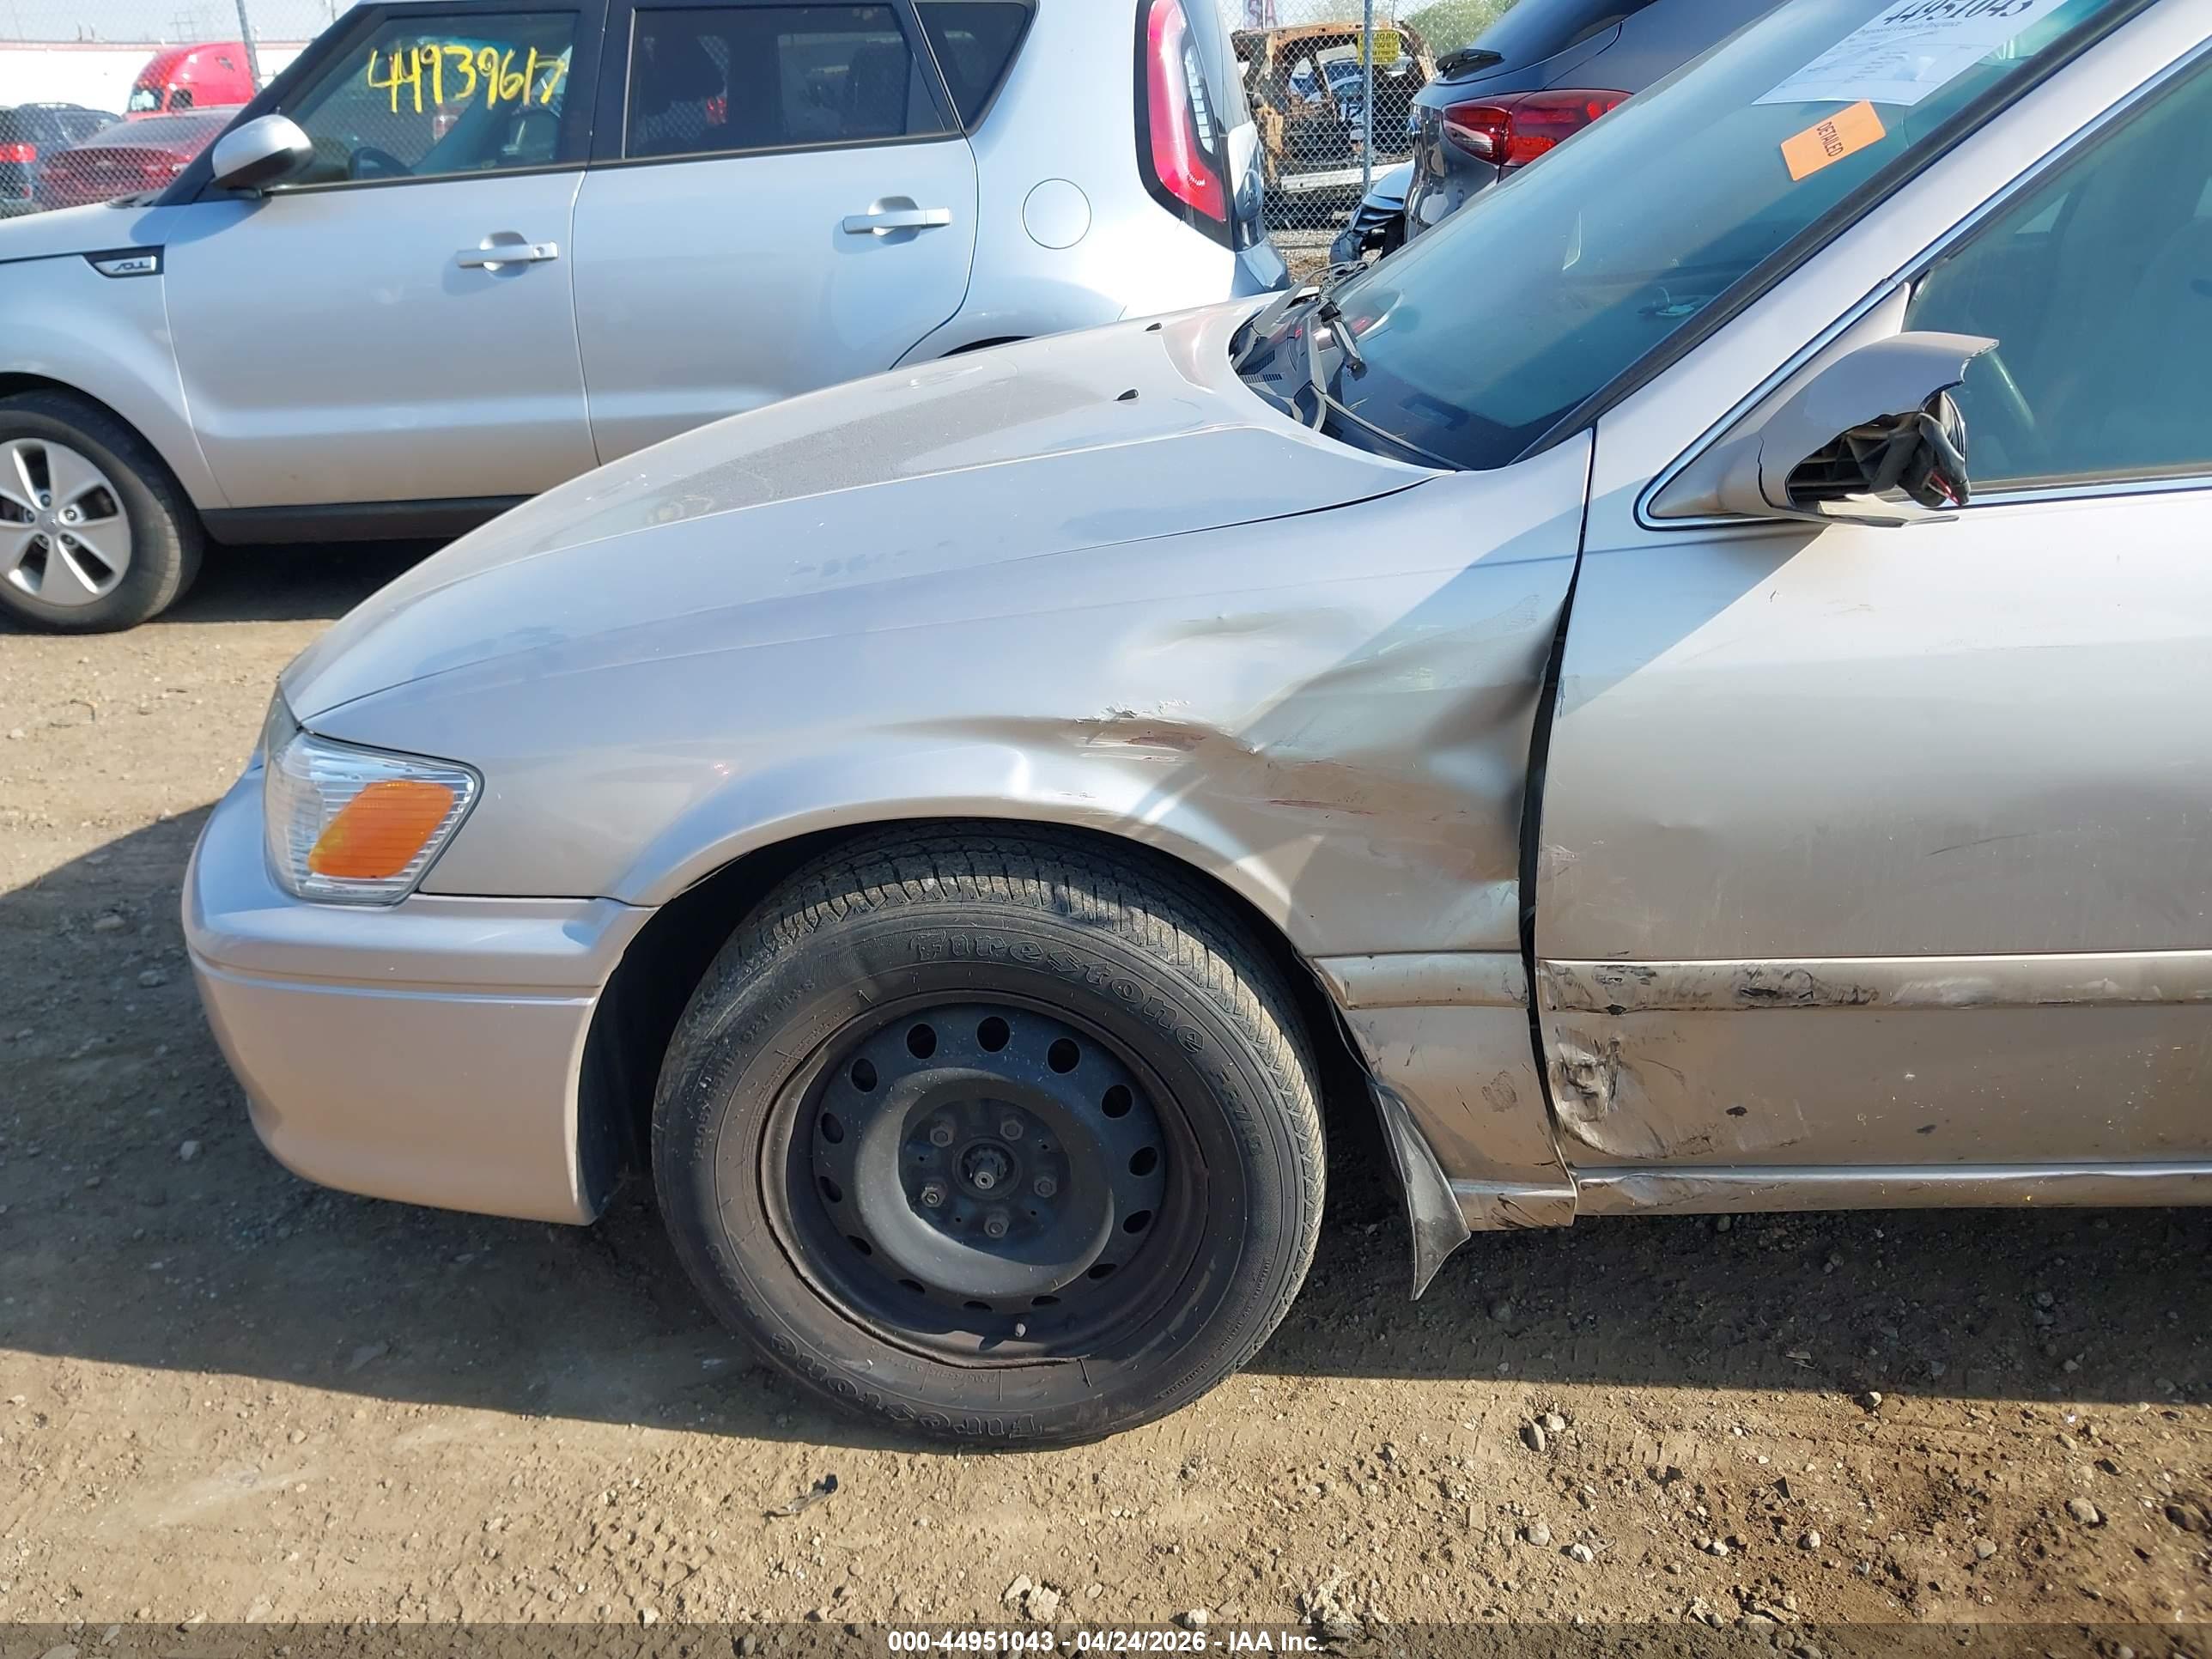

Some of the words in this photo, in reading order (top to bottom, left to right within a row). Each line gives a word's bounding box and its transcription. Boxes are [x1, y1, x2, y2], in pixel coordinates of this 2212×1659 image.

[367, 44, 567, 113] 44939617
[1816, 121, 1844, 157] DETAILED
[909, 930, 1206, 1054] Firestone
